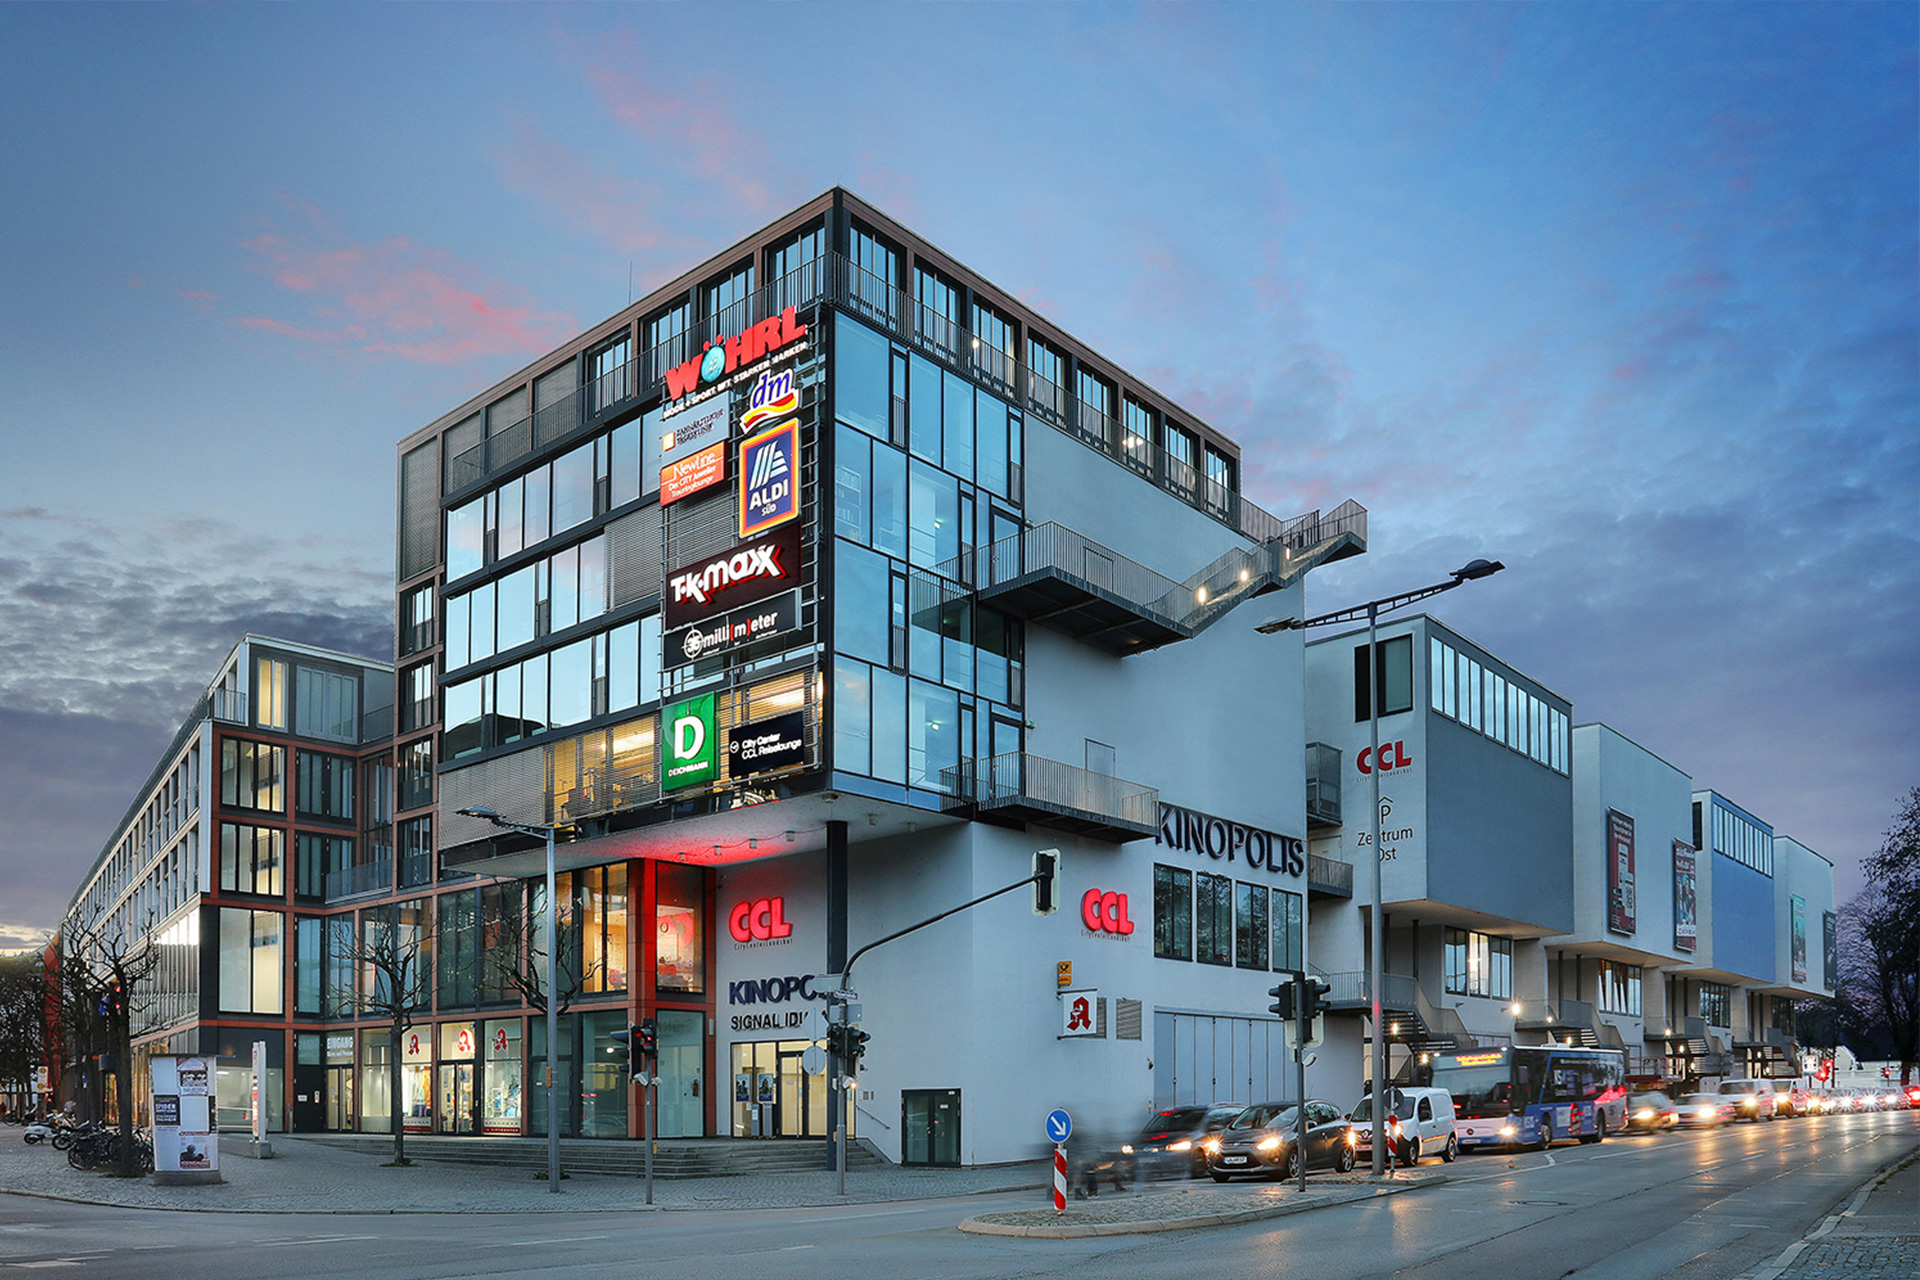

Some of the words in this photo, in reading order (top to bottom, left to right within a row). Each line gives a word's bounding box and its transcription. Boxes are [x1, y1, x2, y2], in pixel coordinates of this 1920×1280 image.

[665, 305, 806, 401] WÖHRL
[734, 360, 770, 384] STARKEN
[772, 342, 808, 363] MARKEN
[753, 372, 790, 408] dm
[749, 479, 789, 511] ALDI
[761, 503, 777, 517] SÜD
[674, 715, 705, 760] D
[742, 737, 757, 750] City
[759, 737, 803, 757] Reiselounge
[668, 761, 709, 777] DEICHMANN
[1357, 741, 1412, 775] CCL
[1381, 804, 1391, 825] P
[1156, 803, 1305, 878] KINOPOLIS
[1357, 827, 1414, 846] Zetrum
[729, 896, 793, 942] CCL
[1081, 888, 1135, 935] CCL
[731, 1012, 780, 1031] SIGNAL
